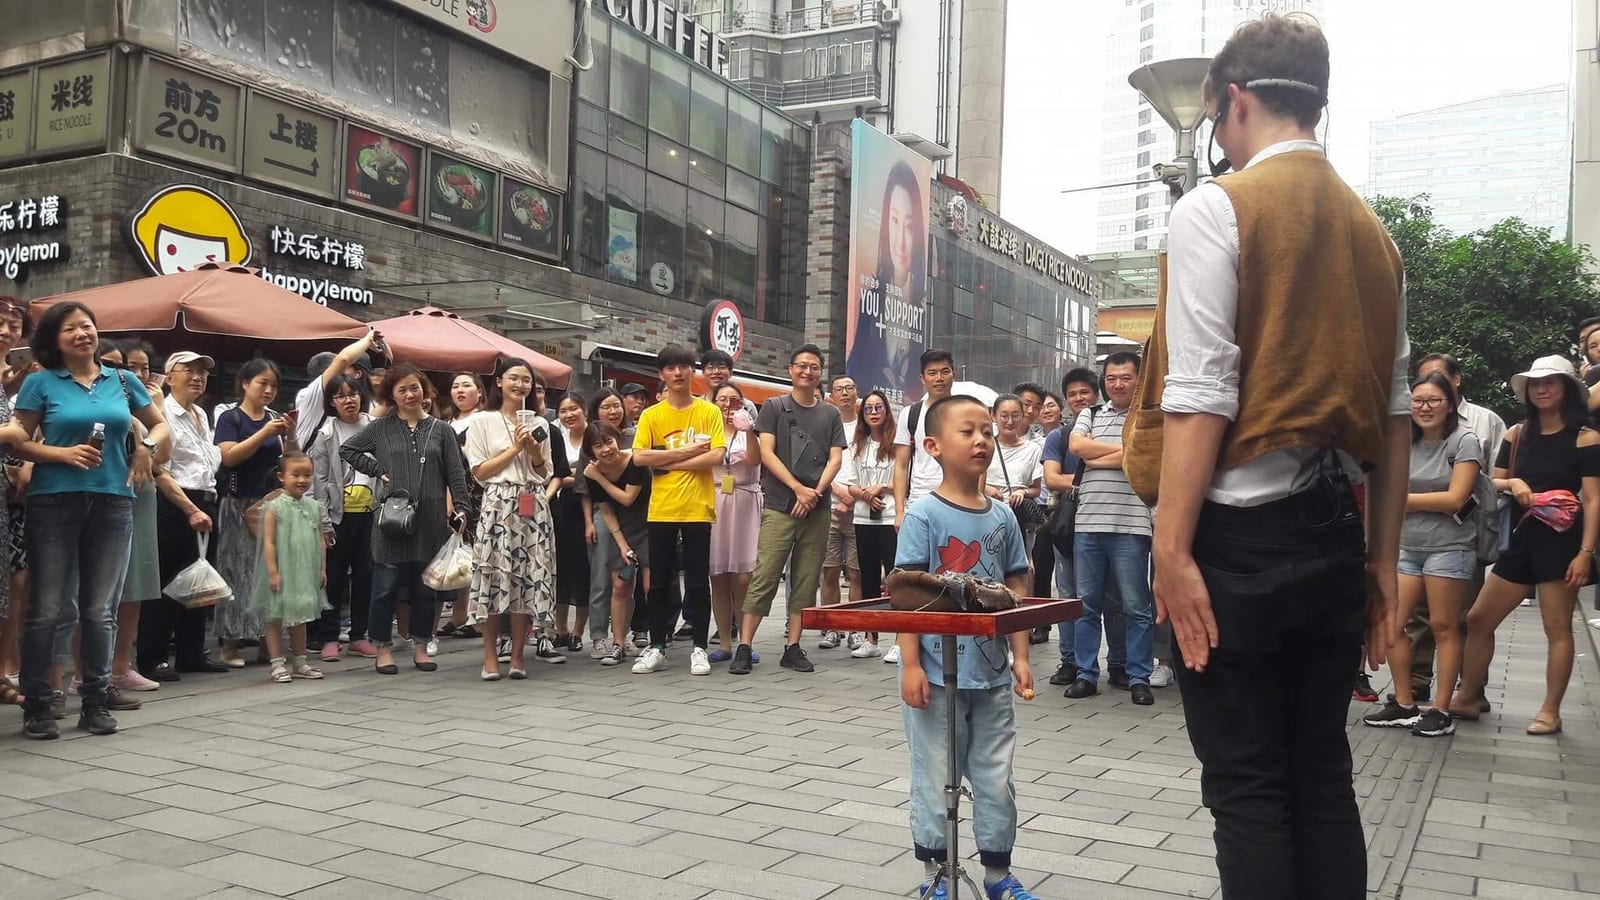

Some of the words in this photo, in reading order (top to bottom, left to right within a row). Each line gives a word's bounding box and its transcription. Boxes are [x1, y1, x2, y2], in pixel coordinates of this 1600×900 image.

[51, 74, 94, 112] 米线
[165, 78, 222, 122] 前方
[155, 111, 226, 153] 20m
[269, 112, 318, 152] 上楼
[271, 225, 365, 270] 快乐柠檬
[979, 217, 1018, 260] 大鼓米线
[261, 266, 374, 308] happylemon
[1025, 242, 1048, 274] DAGU
[1049, 254, 1065, 282] RICE
[1065, 263, 1092, 296] NOODLE
[860, 287, 880, 318] YOU
[884, 295, 924, 331] SUPPORT
